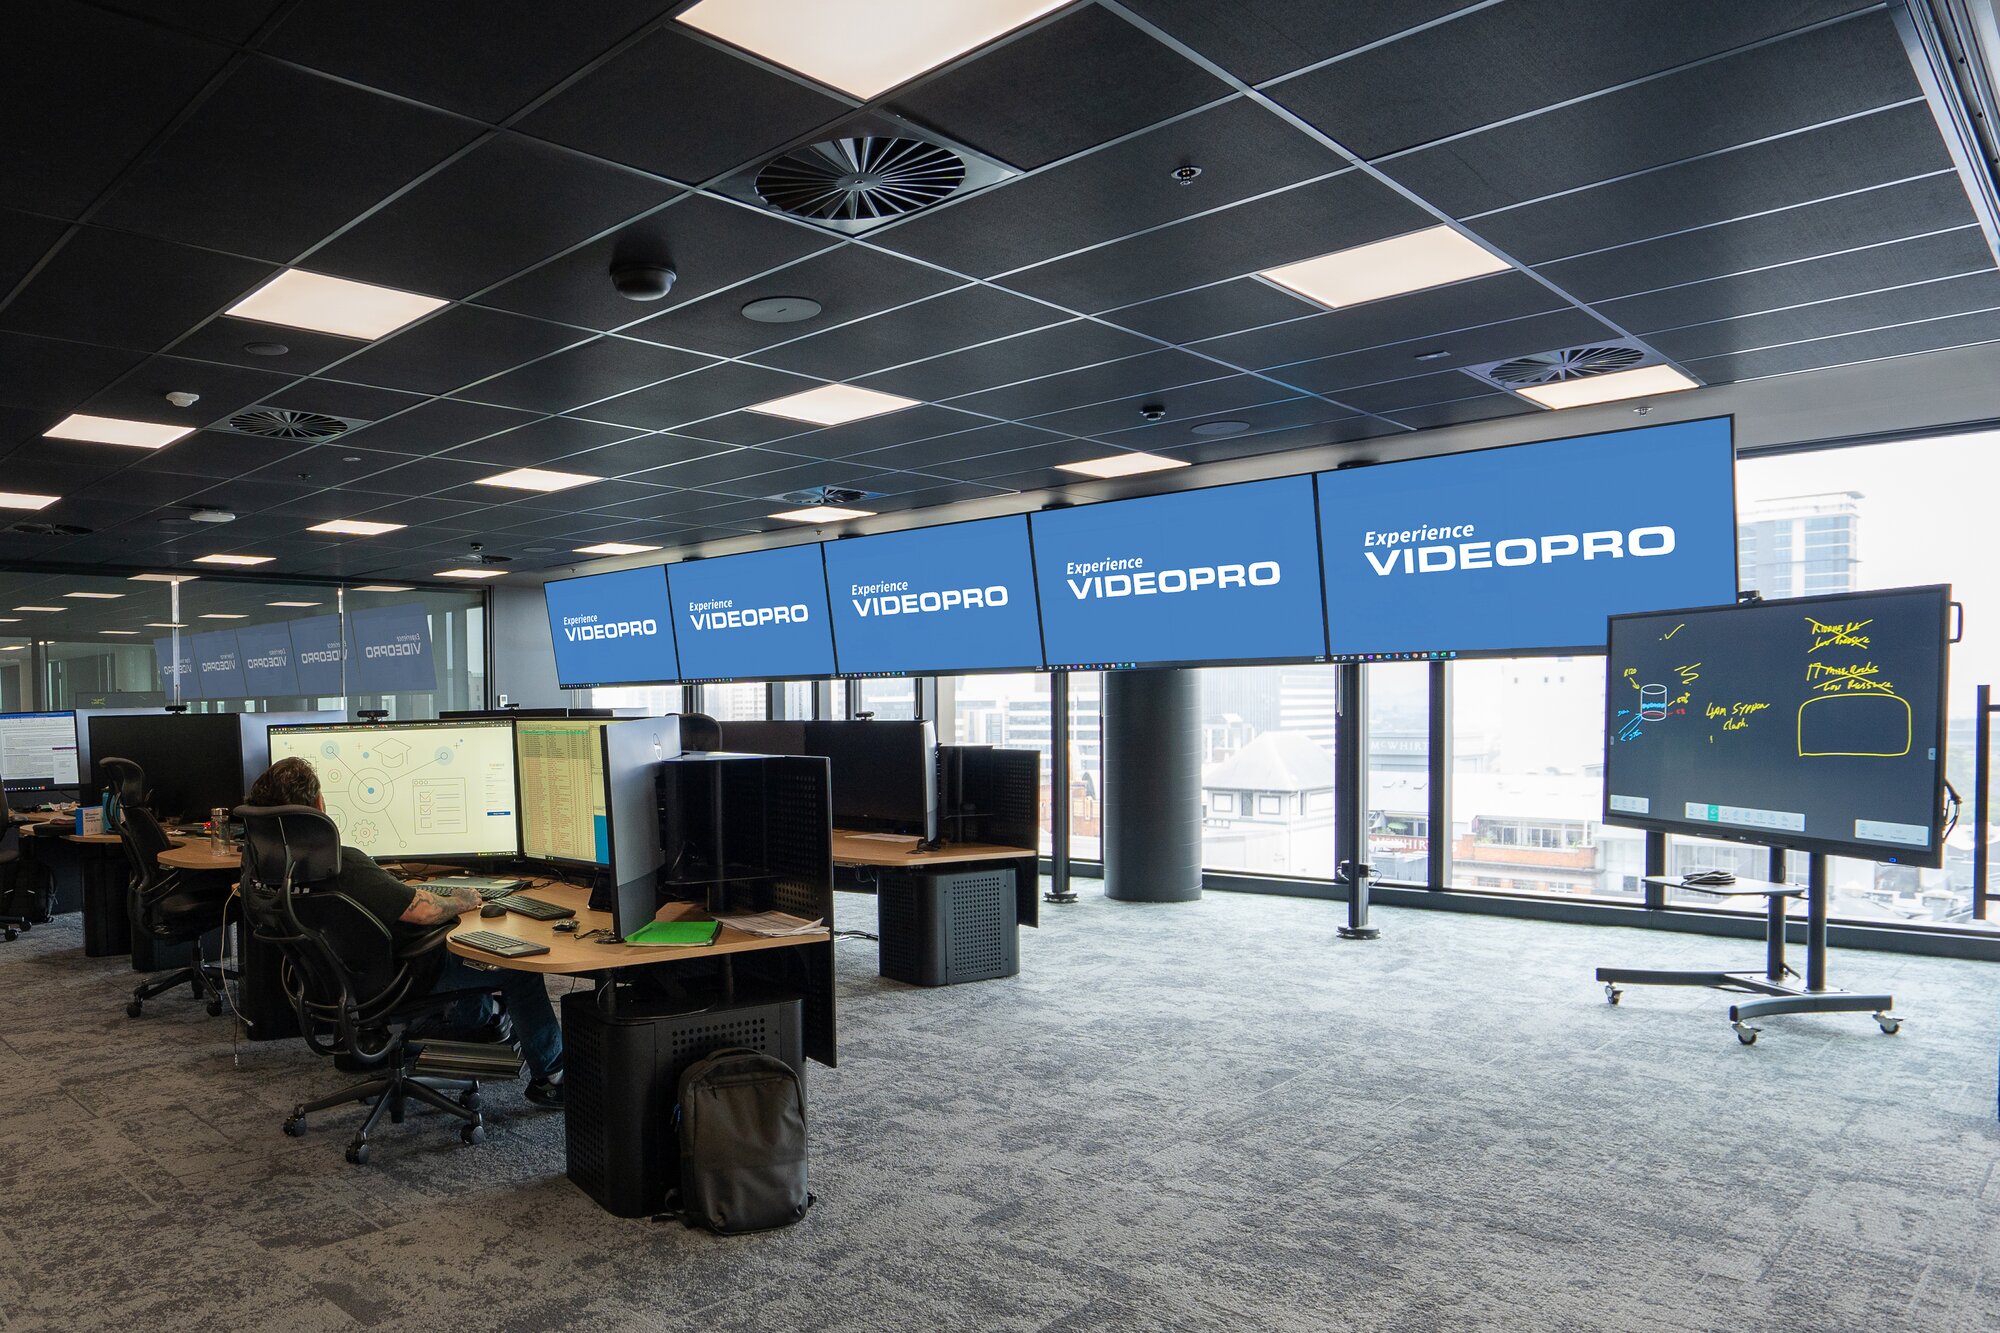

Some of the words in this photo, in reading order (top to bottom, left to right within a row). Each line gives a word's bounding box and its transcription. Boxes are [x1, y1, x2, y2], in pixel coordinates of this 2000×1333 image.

[1365, 524, 1475, 547] Experience
[1364, 525, 1676, 576] VIDEOPRO
[1066, 557, 1143, 577] Experience
[851, 581, 909, 597] Experience
[1066, 560, 1281, 600] VIDEOPRO
[689, 598, 733, 613] Experience
[851, 585, 1009, 617] VIDEOPRO
[563, 613, 598, 626] Experience
[689, 604, 809, 631] VIDEOPRO
[564, 618, 657, 642] VIDEOPRO
